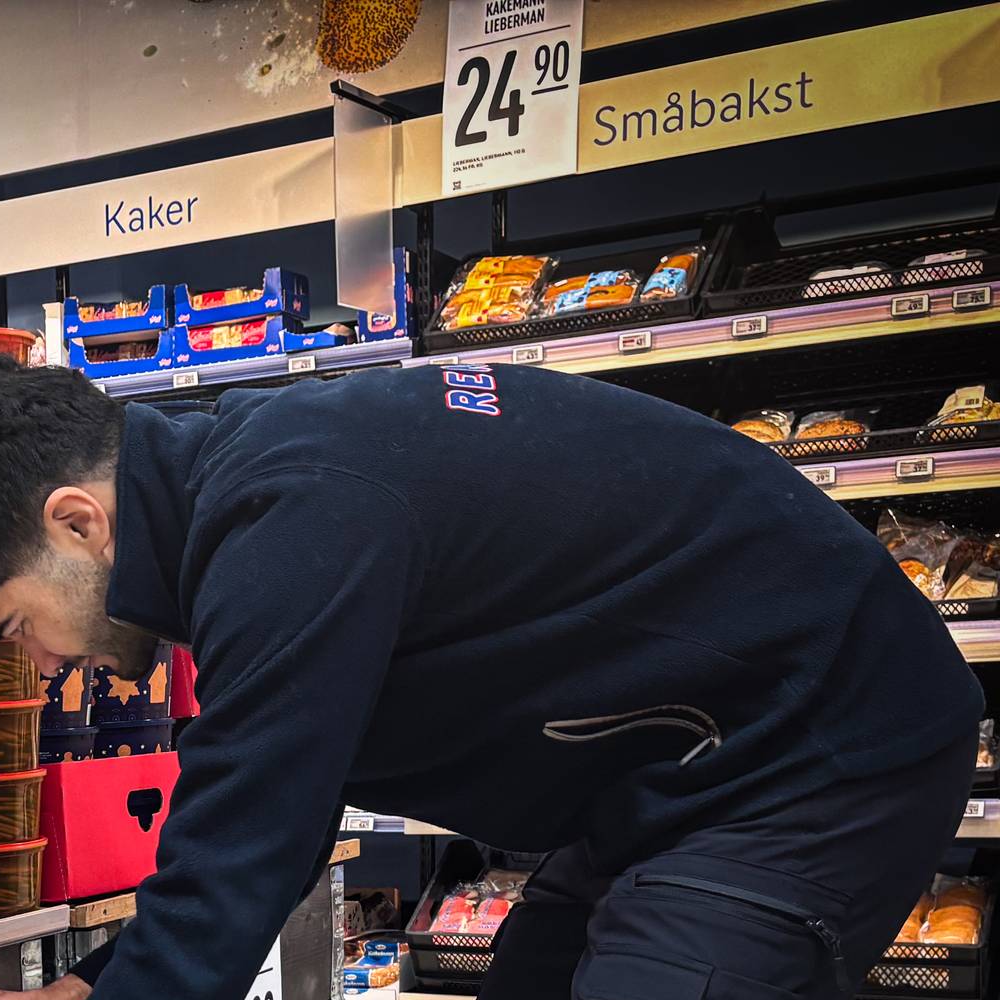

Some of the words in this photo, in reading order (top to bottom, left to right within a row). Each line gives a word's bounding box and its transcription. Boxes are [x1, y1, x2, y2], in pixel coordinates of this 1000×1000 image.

[484, 8, 545, 35] LIEBERMAN
[455, 49, 525, 148] 24
[534, 40, 570, 86] 90
[593, 71, 814, 147] Småbakst
[105, 196, 198, 237] Kaker
[443, 364, 502, 416] RE
